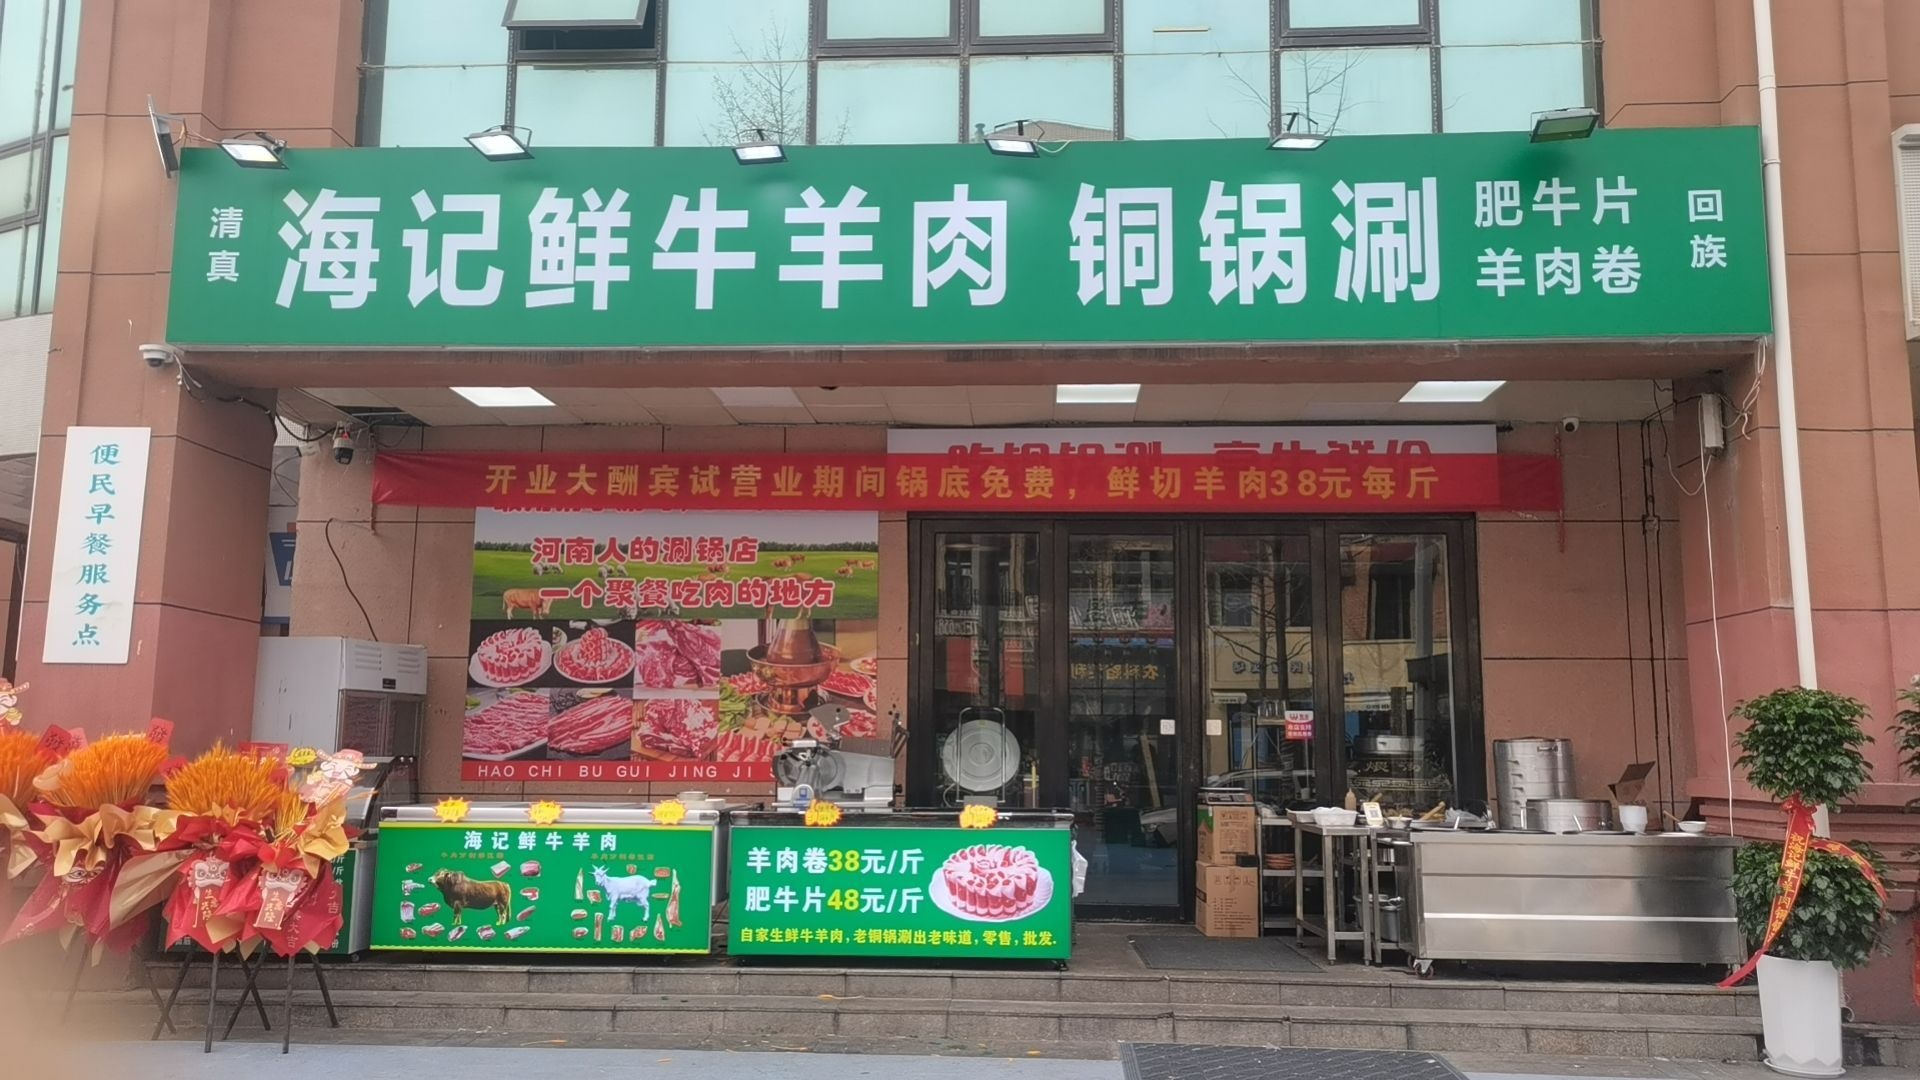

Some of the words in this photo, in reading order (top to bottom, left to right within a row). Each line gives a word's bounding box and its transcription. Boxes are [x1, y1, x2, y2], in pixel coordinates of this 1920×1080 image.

[1474, 176, 1639, 229] 肥牛片
[206, 206, 244, 283] 清真
[275, 183, 1009, 311] 海记鲜牛羊肉
[1069, 176, 1441, 307] 铜锅涮
[1687, 189, 1728, 269] 回族
[1475, 245, 1643, 297] 羊肉卷
[72, 443, 121, 647] 便民早餐服务点
[531, 535, 759, 565] 河南人的涮锅店
[539, 577, 835, 609] 一个聚餐吃肉的地方
[478, 764, 515, 778] HAO
[528, 764, 562, 778] CHI
[578, 764, 603, 778] BU
[616, 764, 650, 778] GUI
[668, 764, 717, 779] JING
[733, 764, 752, 779] JI
[463, 830, 618, 852] 海记鲜牛羊肉
[746, 846, 925, 875] 羊肉卷38元/斤
[744, 885, 924, 914] 肥牛片48元/斤
